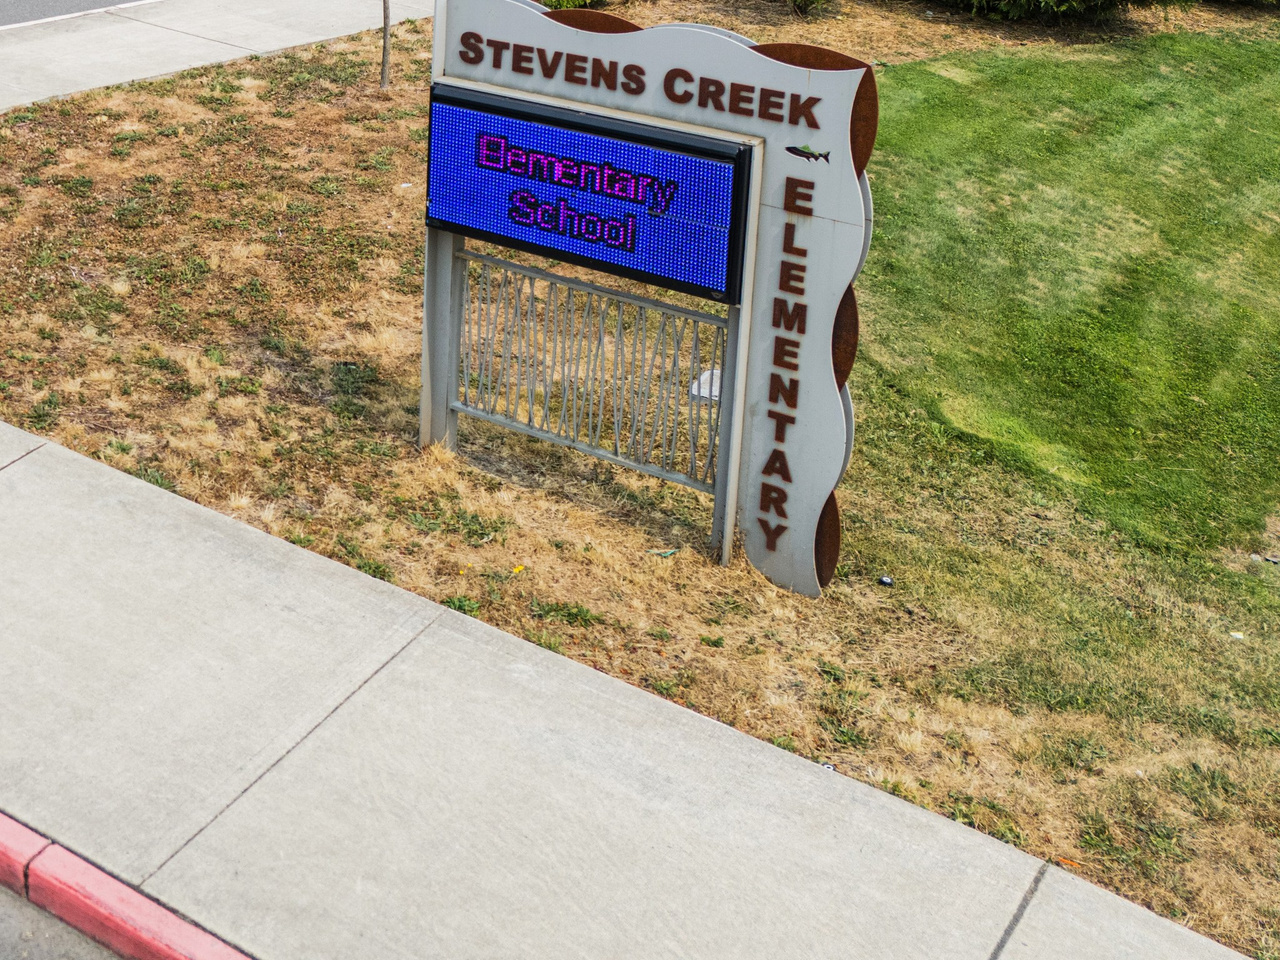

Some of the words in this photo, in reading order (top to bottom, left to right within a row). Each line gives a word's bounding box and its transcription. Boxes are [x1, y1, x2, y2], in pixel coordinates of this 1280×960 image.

[458, 31, 646, 96] STEVENS
[663, 68, 823, 130] CREEK
[479, 134, 675, 215] Elementary
[512, 191, 637, 250] School
[753, 176, 816, 552] ELEMENTARY
